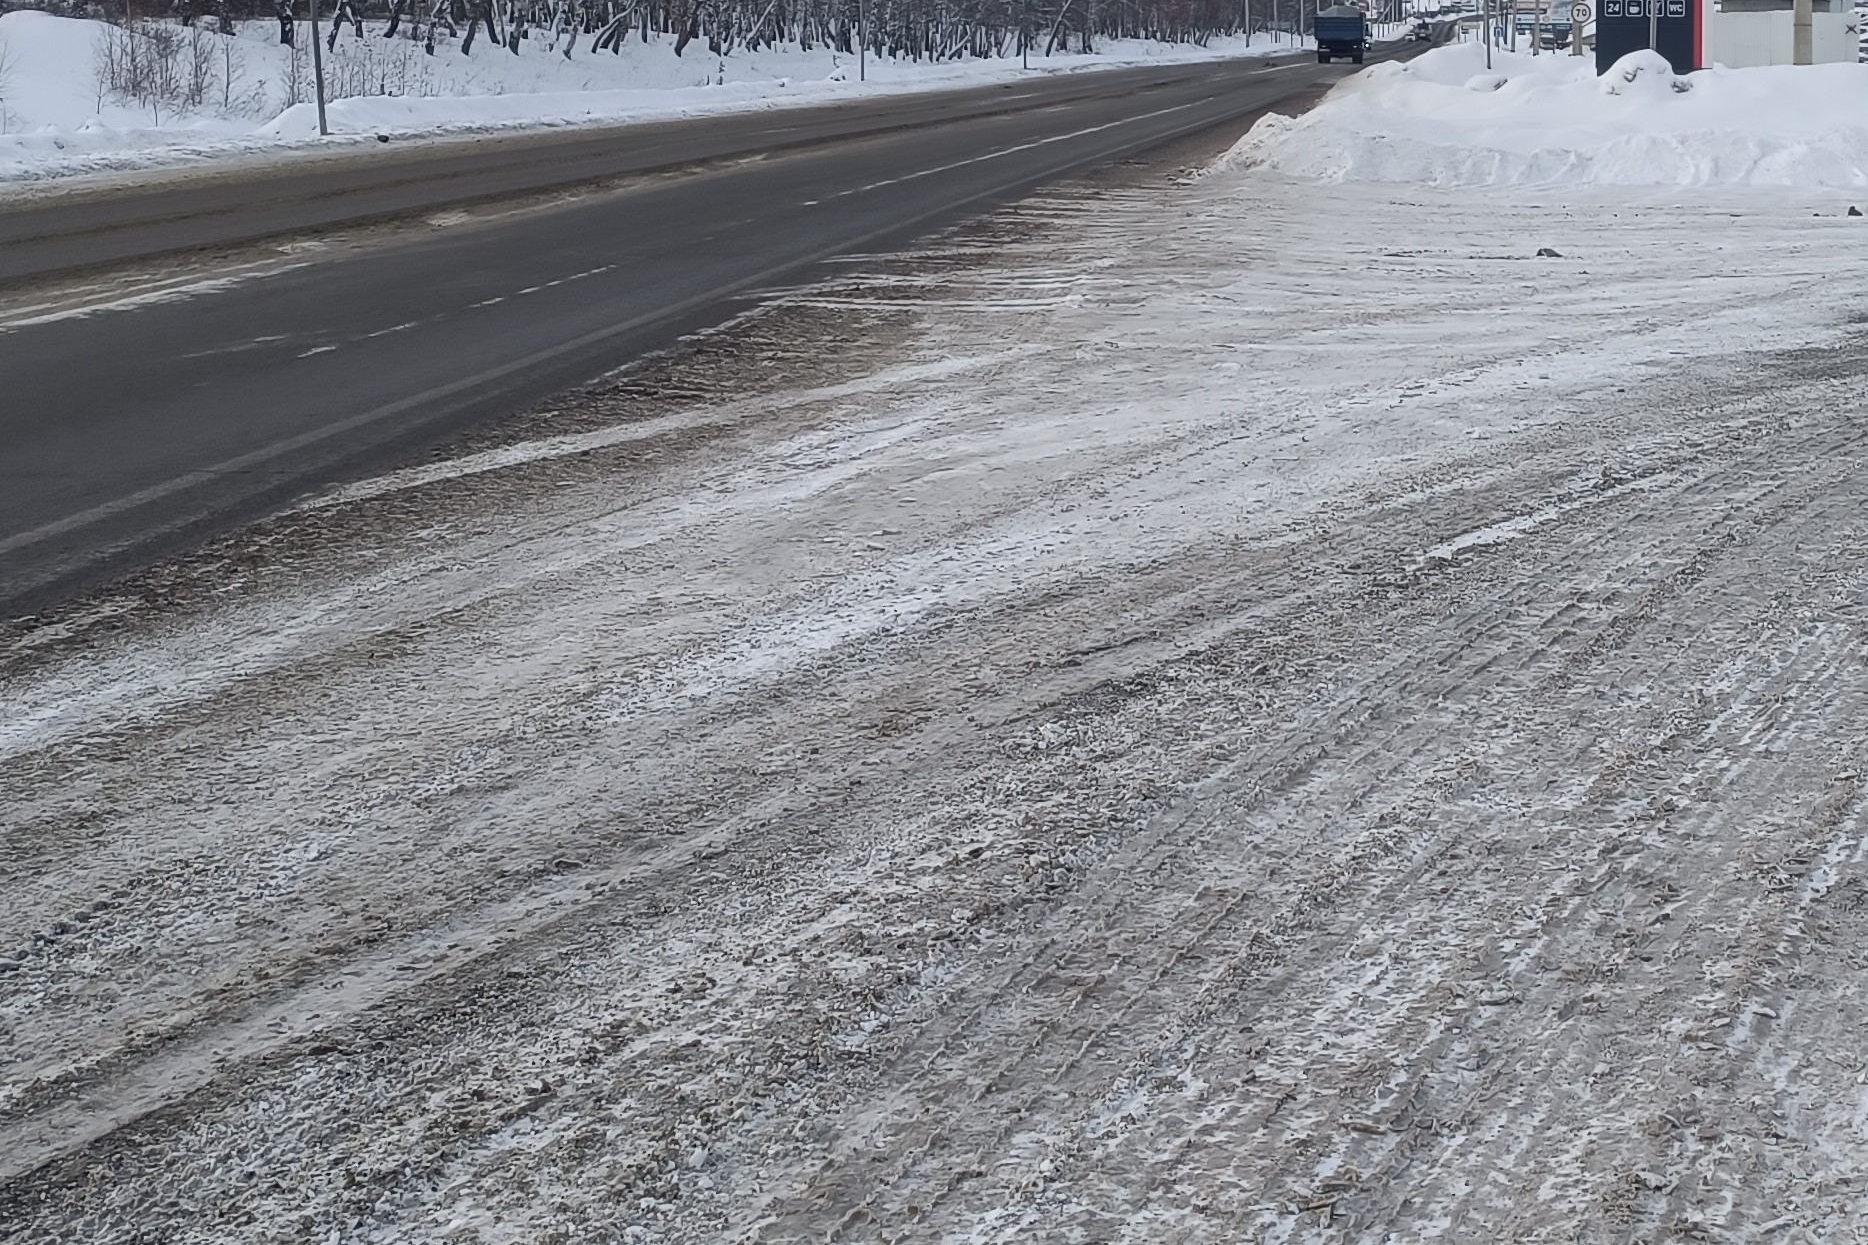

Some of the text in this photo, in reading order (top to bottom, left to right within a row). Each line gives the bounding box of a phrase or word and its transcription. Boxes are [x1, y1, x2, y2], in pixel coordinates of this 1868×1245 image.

[1607, 3, 1683, 12] 24 WC
[1575, 8, 1587, 18] 70
